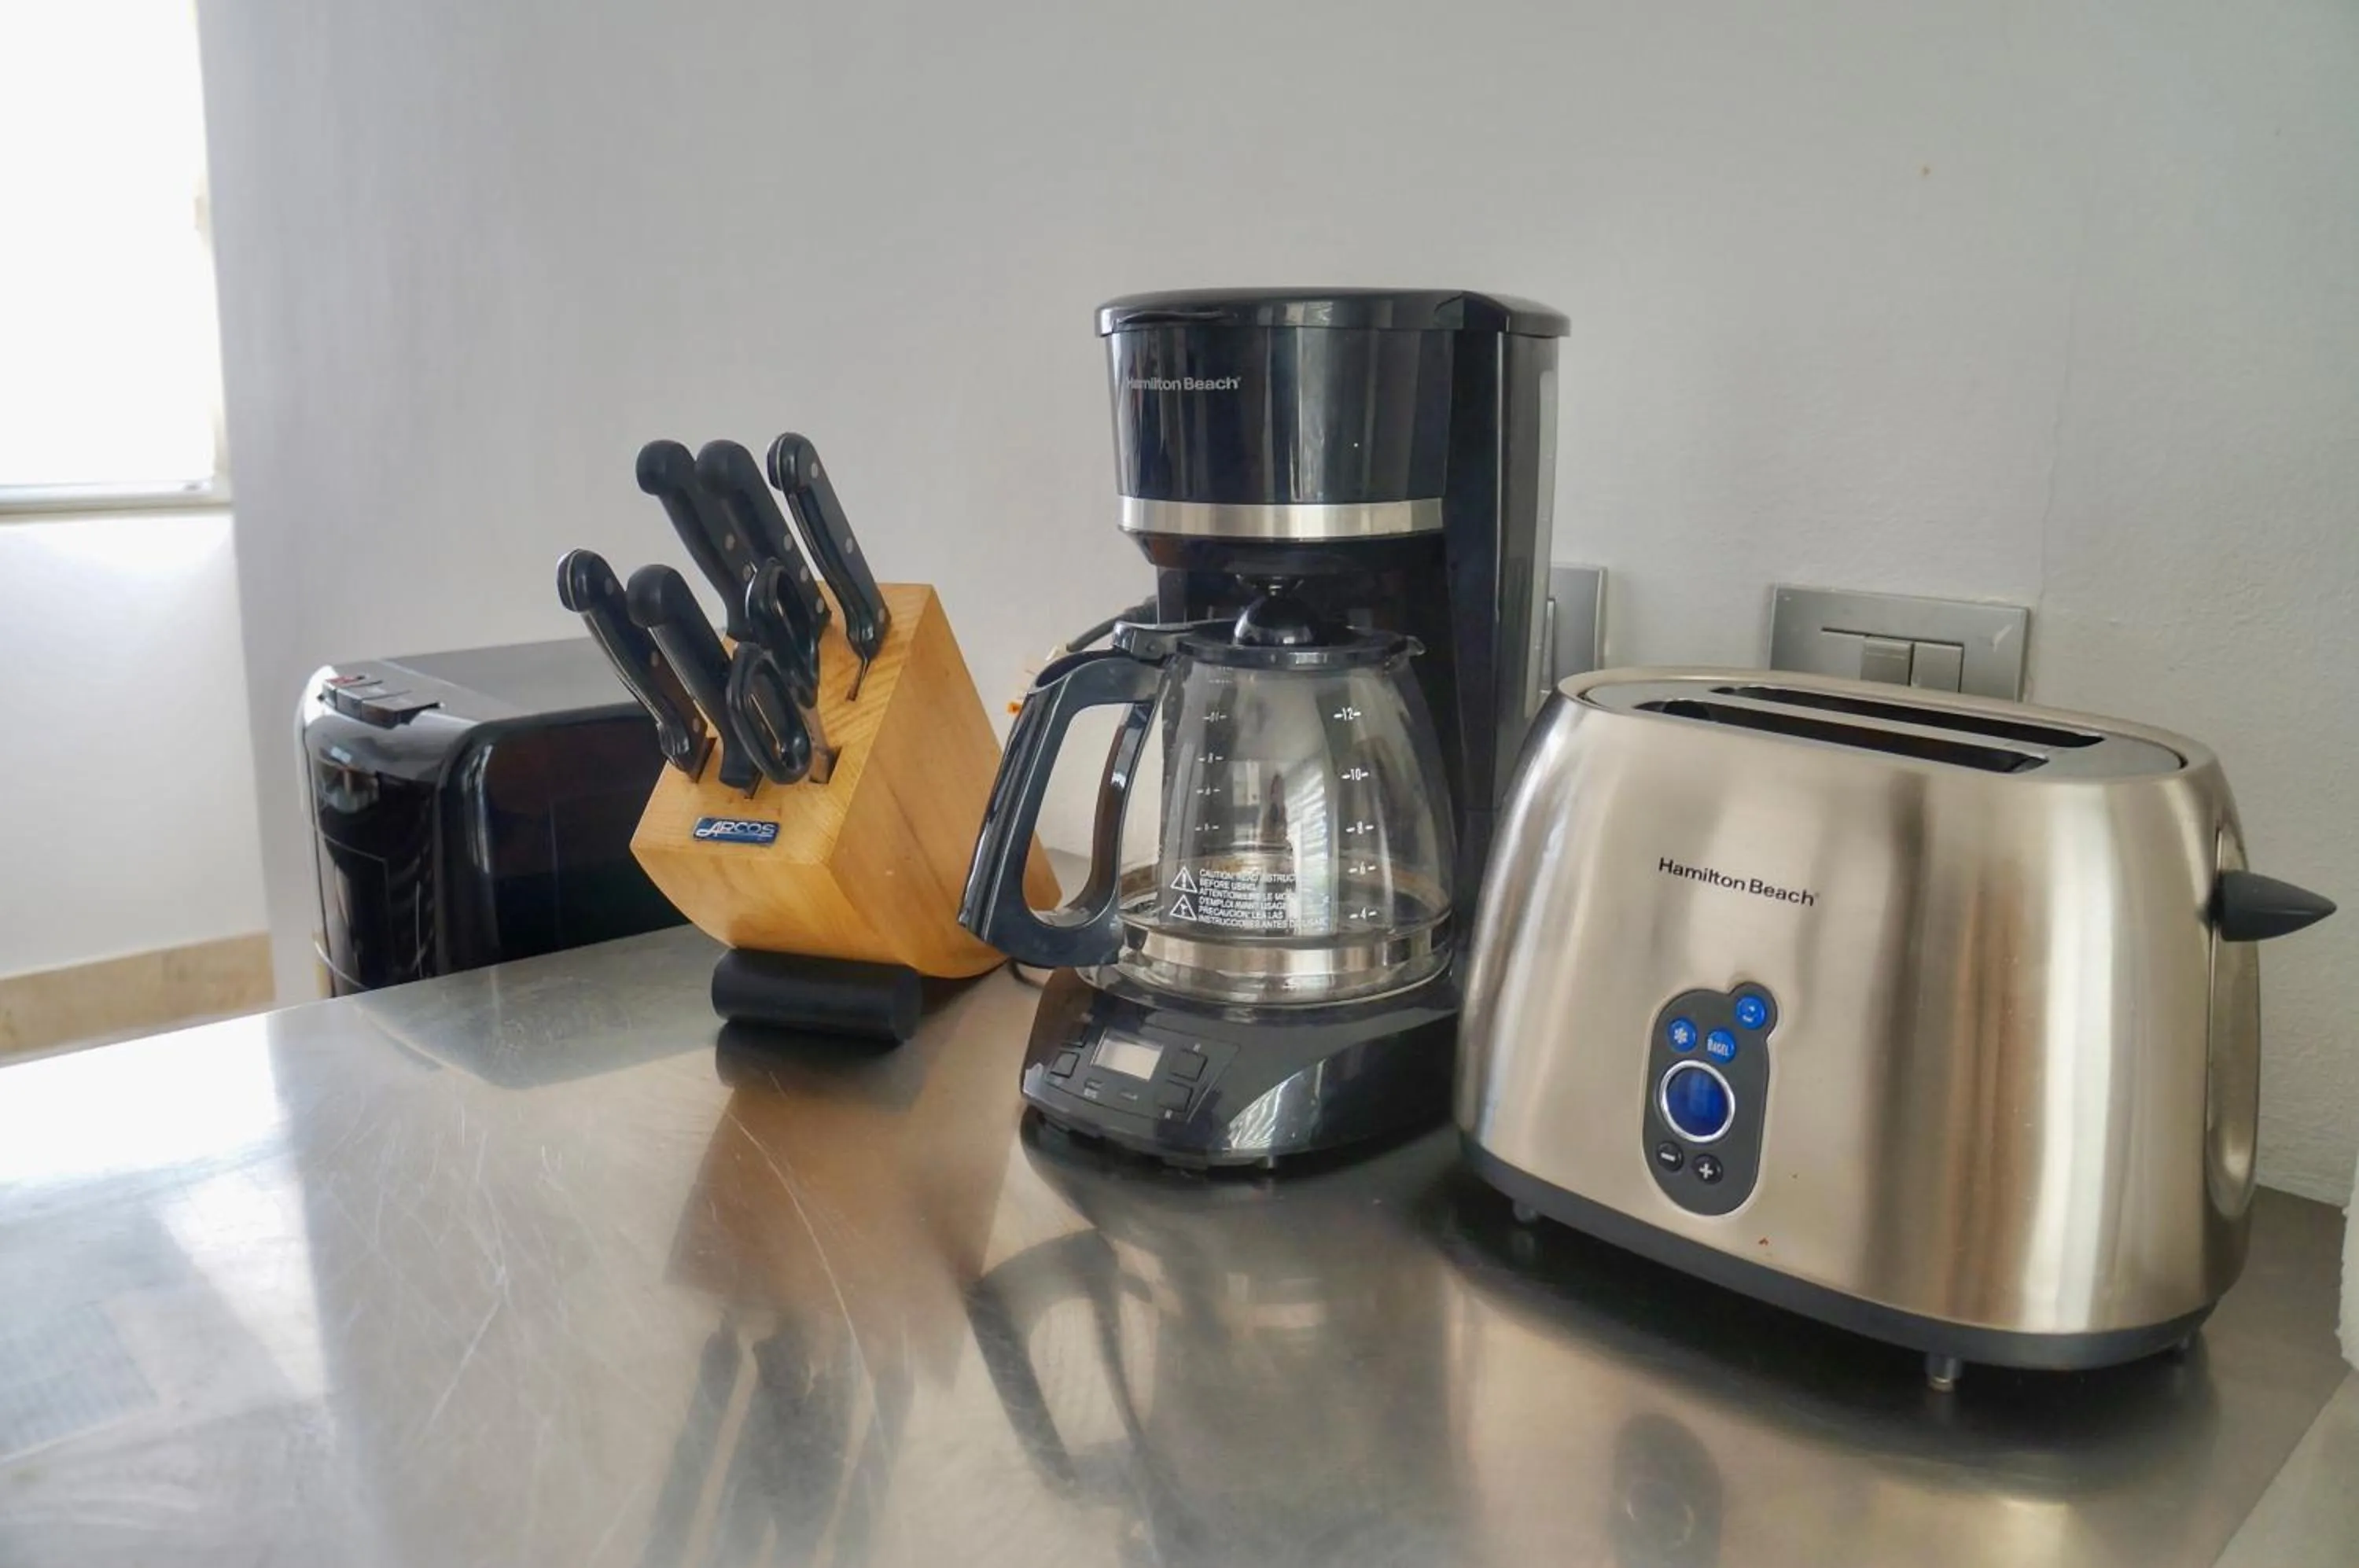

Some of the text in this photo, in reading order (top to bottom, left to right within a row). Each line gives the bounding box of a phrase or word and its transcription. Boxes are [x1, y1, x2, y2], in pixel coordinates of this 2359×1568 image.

[1125, 376, 1238, 390] Hamilton Beach
[696, 820, 775, 837] ARCOS
[1658, 857, 1814, 906] Hamilton Beach
